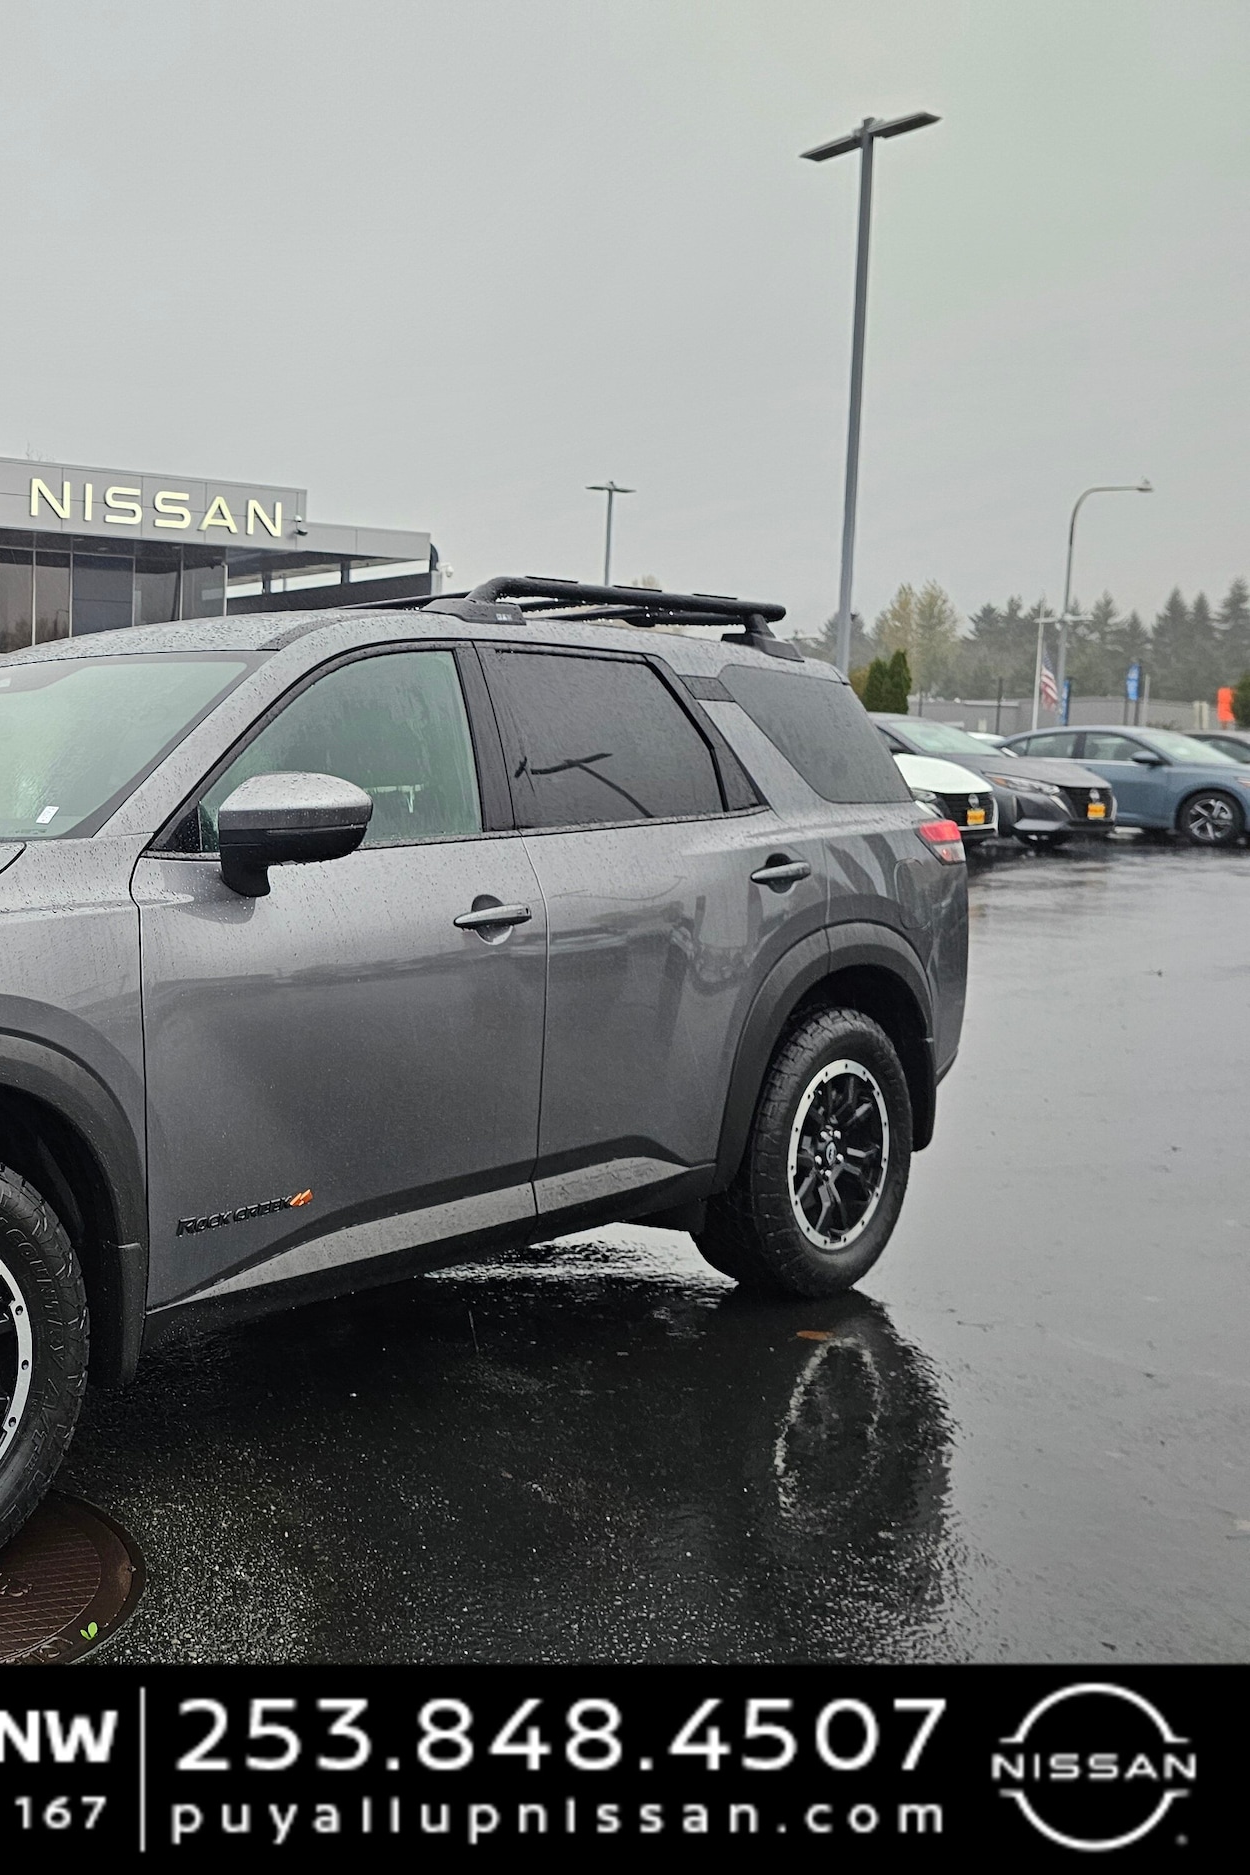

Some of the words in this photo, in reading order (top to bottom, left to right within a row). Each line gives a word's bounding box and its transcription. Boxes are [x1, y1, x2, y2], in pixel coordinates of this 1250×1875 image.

[30, 477, 283, 538] NISSAN
[176, 1209, 233, 1237] ROCK
[232, 1195, 294, 1223] CREEK
